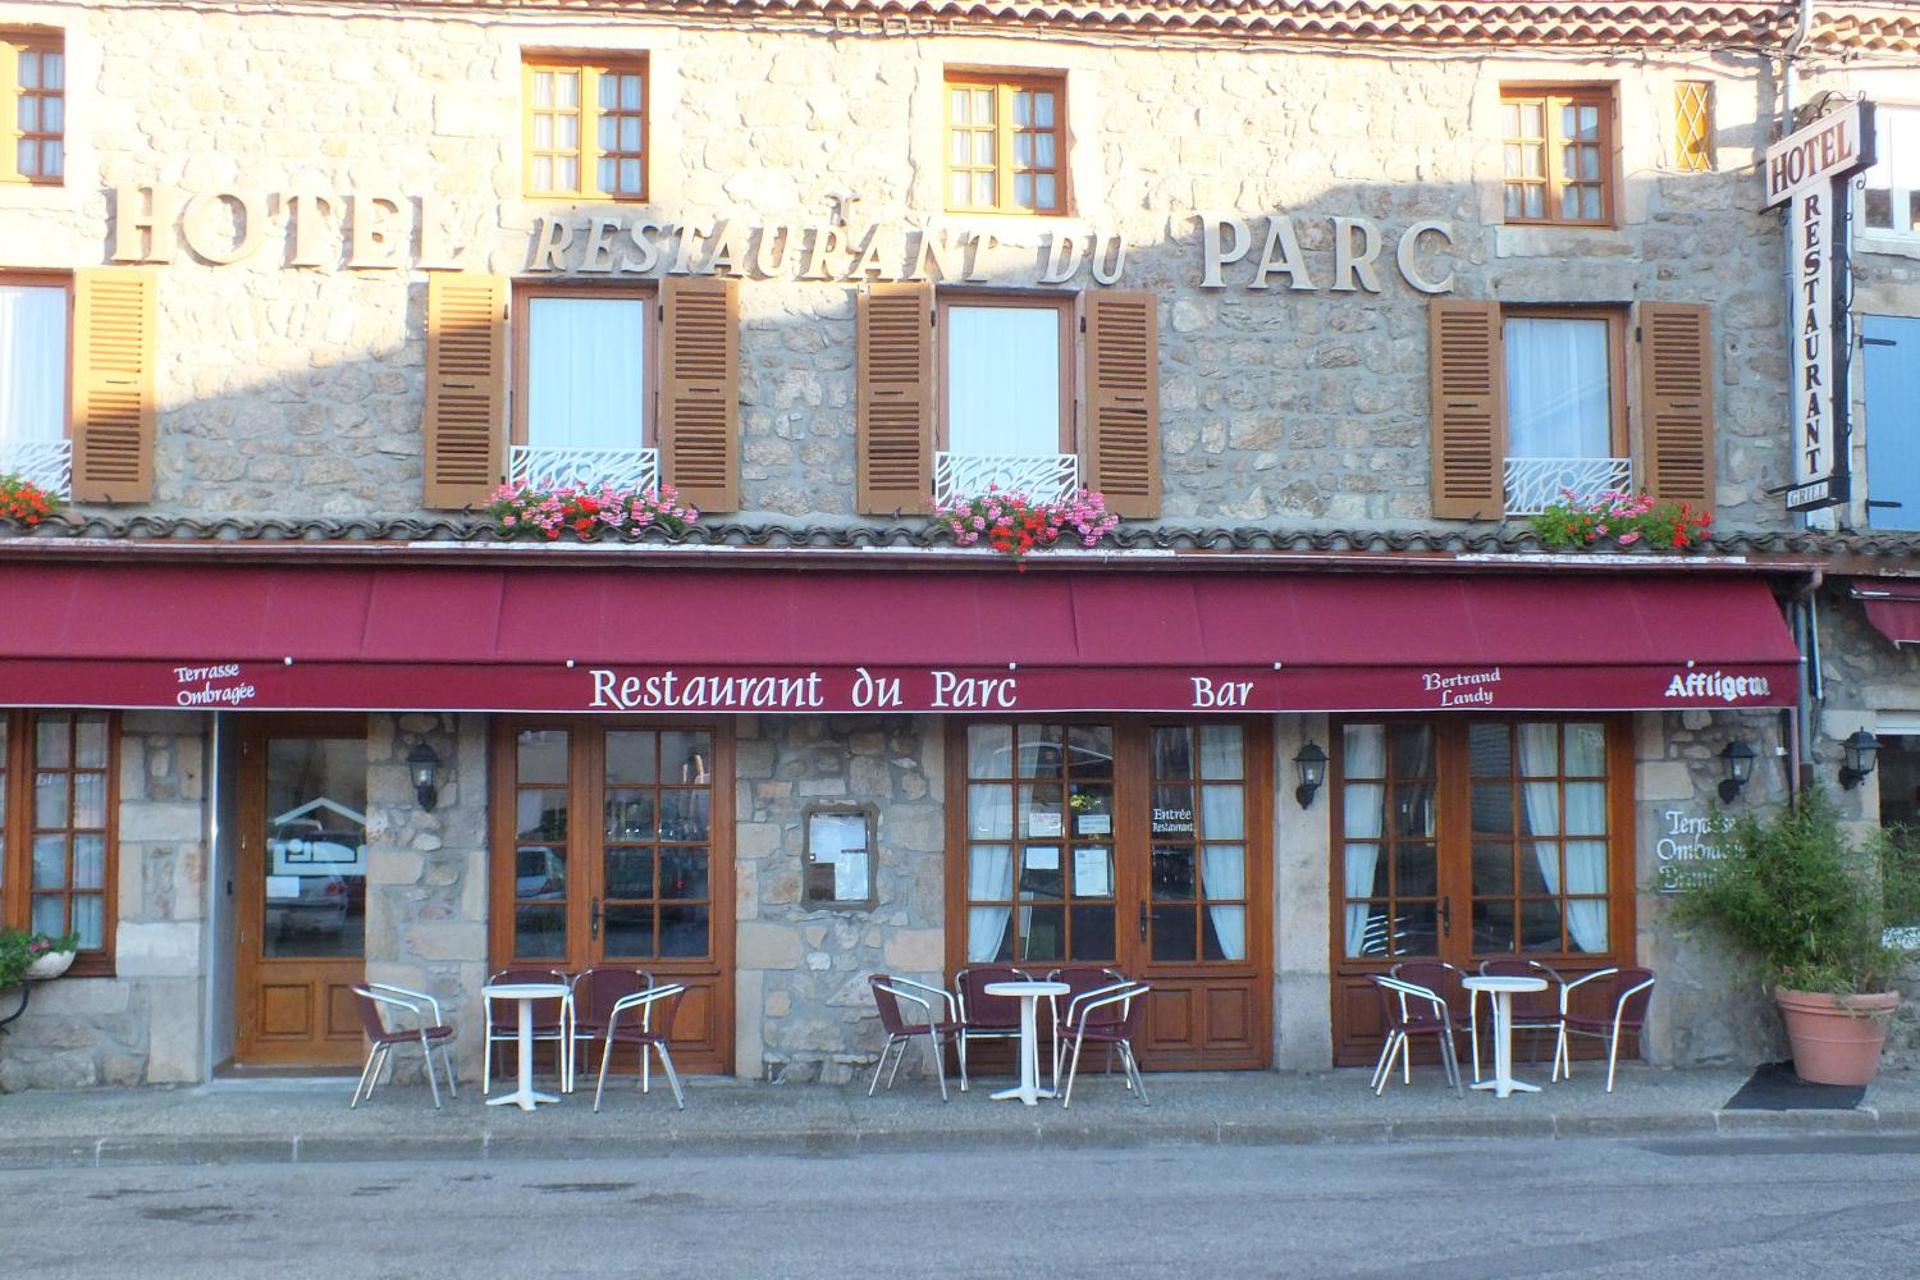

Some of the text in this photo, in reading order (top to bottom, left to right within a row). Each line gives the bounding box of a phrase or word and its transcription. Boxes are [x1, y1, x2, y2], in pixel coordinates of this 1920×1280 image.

[1771, 119, 1853, 196] HOTEL
[106, 186, 466, 271] HOTEL
[526, 213, 1454, 294] RESTAURANT DU PARC
[1803, 193, 1822, 475] RESTAURANT
[1790, 484, 1826, 506] GRILL
[174, 664, 240, 683] Terrasse
[589, 667, 1017, 710] Restaurant du Parc
[1422, 667, 1502, 691] Bertrand
[1665, 670, 1771, 702] Affligem
[177, 681, 256, 706] Ombragée
[1191, 677, 1254, 708] Bar
[1440, 686, 1494, 707] Landy
